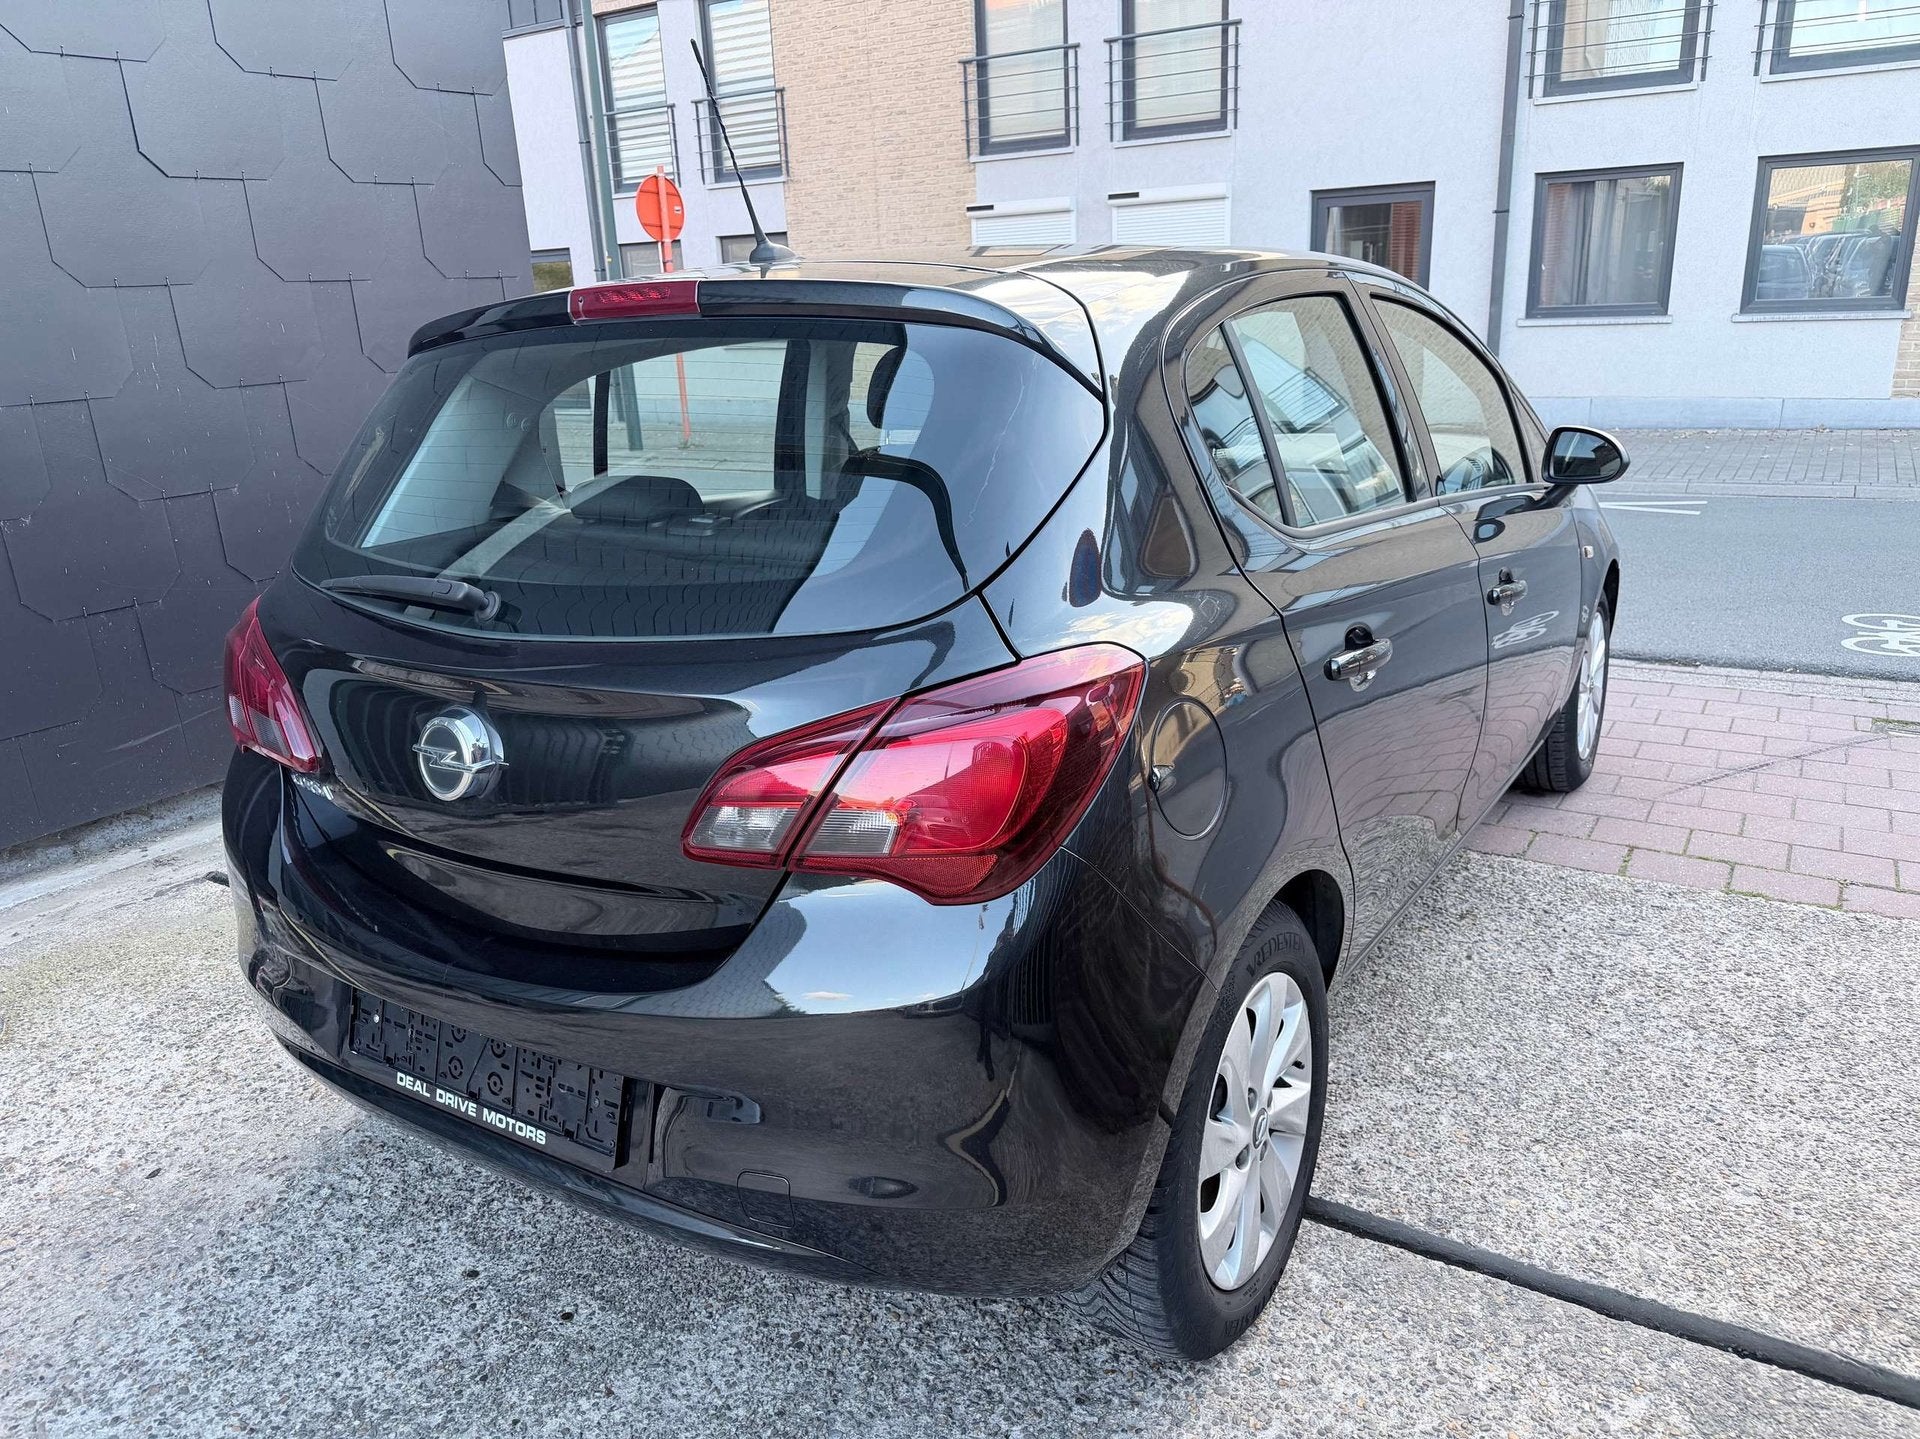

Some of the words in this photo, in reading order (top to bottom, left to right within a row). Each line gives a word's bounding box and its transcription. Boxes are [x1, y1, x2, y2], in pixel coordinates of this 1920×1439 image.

[397, 1071, 431, 1098] DEAL
[435, 1088, 478, 1118] DRIVE
[482, 1107, 547, 1146] MOTORS
